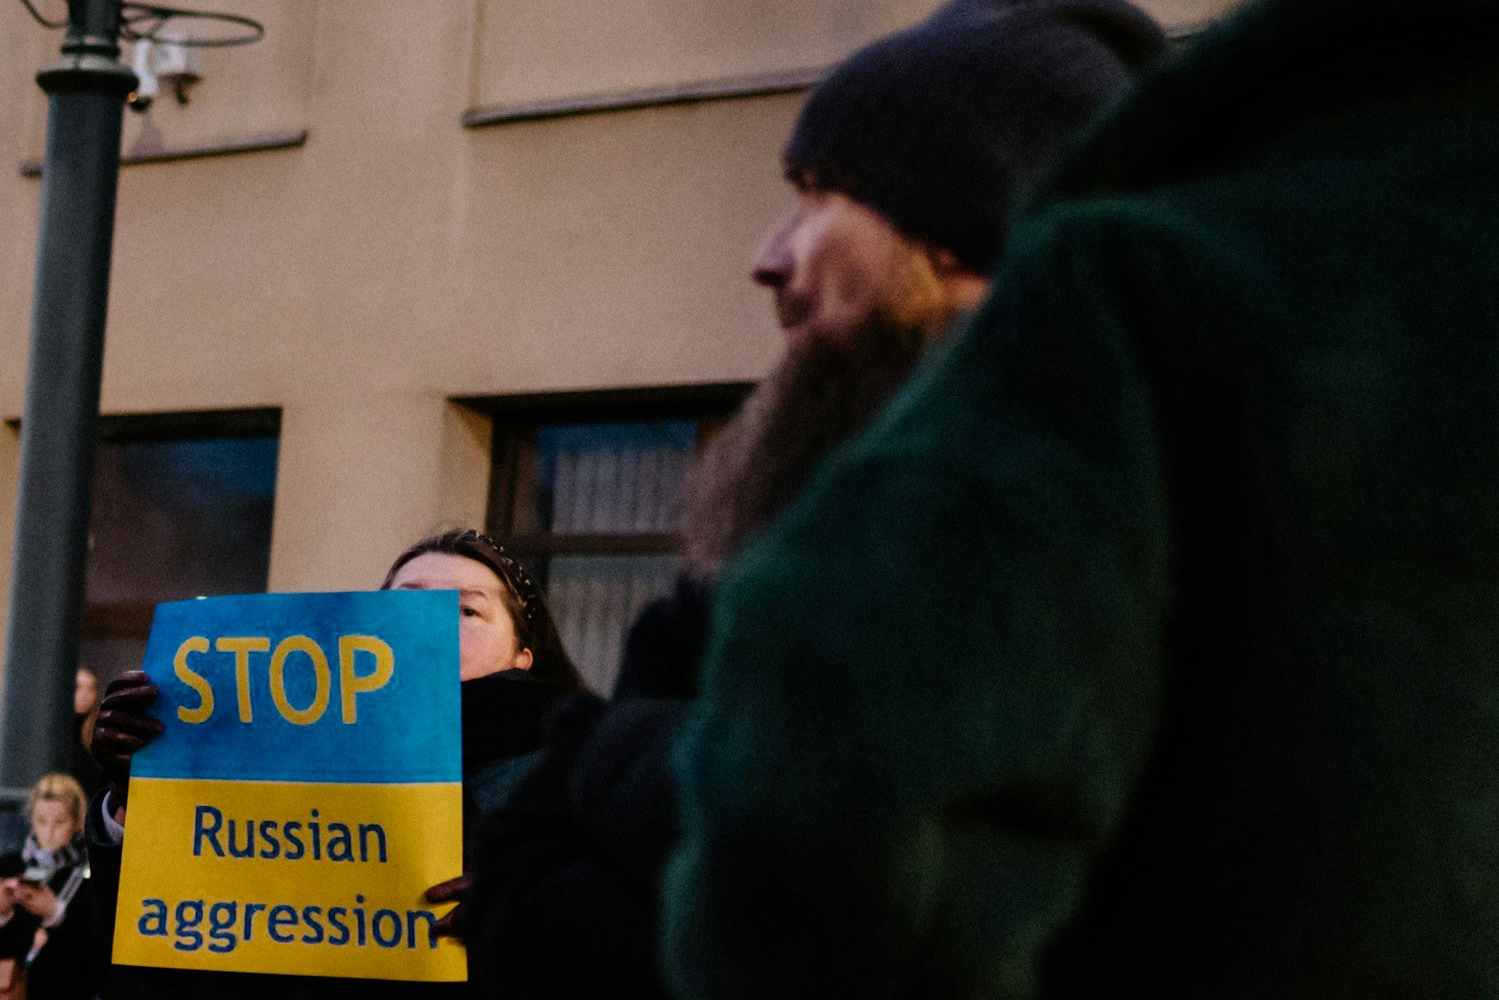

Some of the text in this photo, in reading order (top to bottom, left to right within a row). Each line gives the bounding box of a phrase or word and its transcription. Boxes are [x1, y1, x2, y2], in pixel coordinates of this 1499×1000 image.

[173, 634, 396, 727] STOP
[192, 804, 388, 864] Russian
[137, 894, 439, 954] aggression
